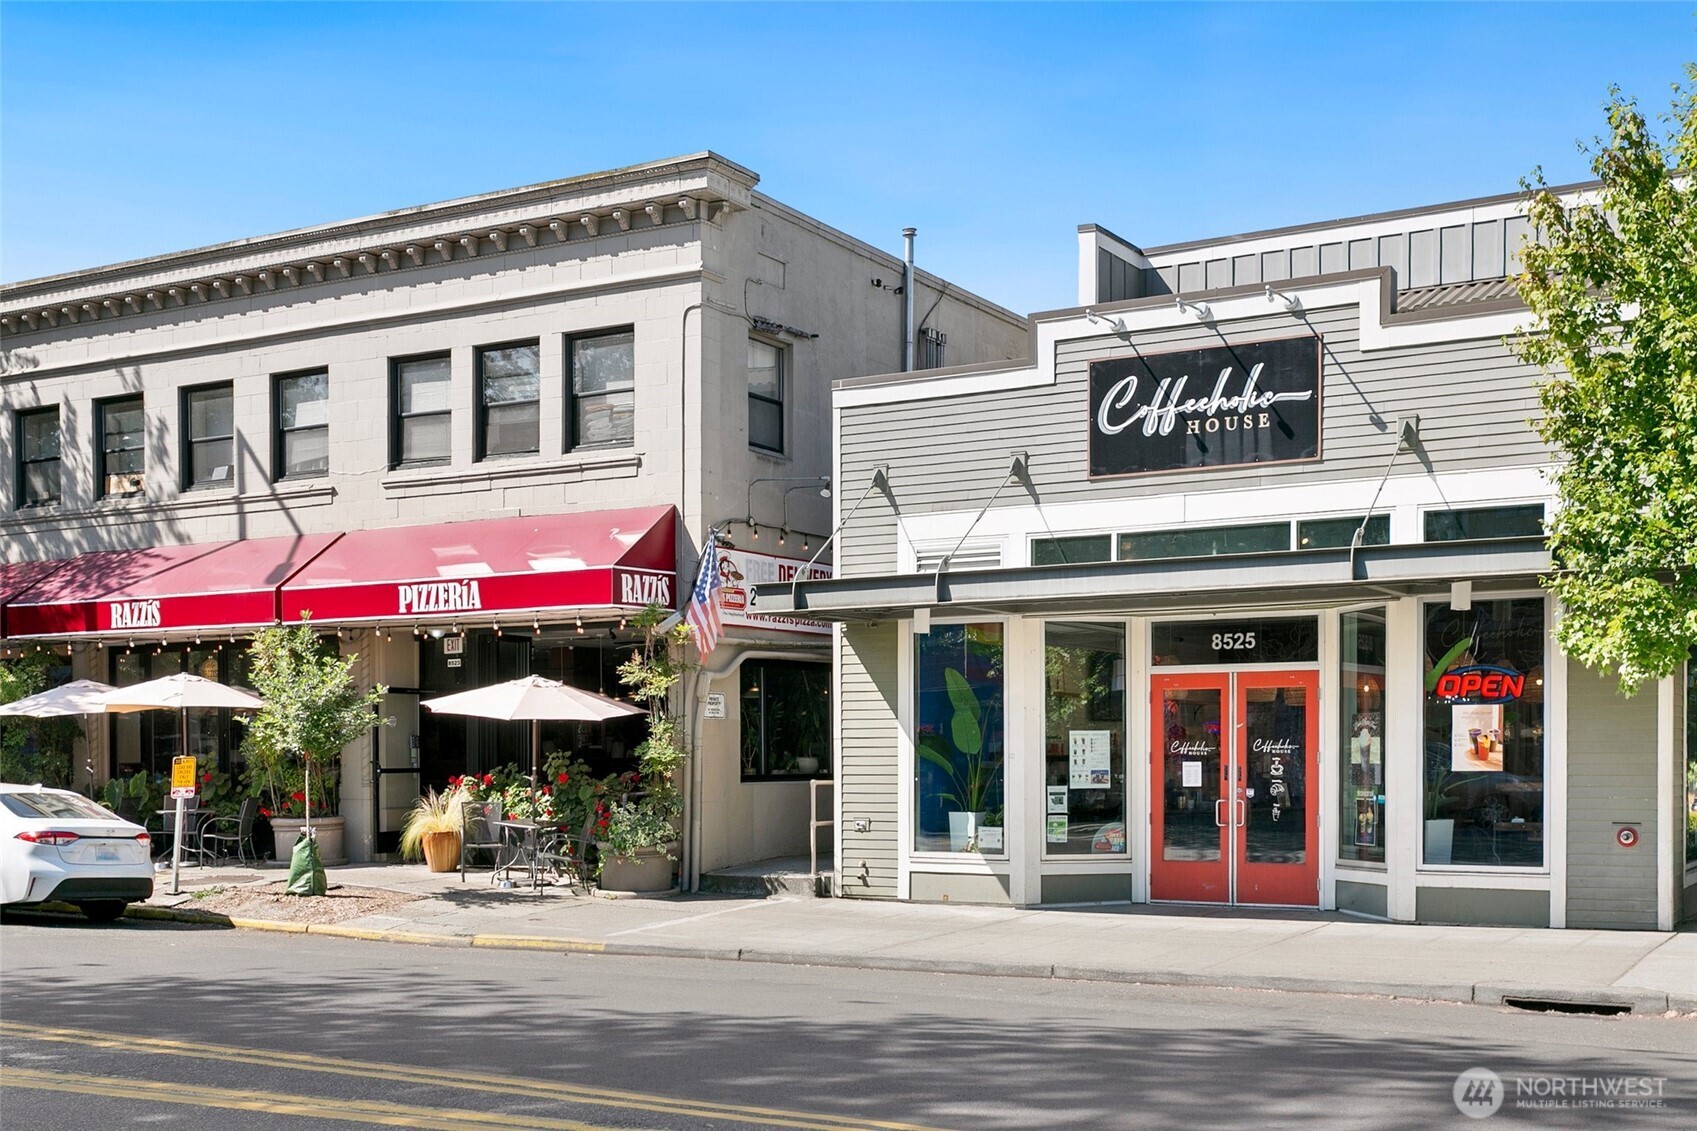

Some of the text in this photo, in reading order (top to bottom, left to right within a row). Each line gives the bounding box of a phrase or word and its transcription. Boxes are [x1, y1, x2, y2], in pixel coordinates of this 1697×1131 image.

[1098, 362, 1312, 437] Coffeeholic
[1186, 412, 1270, 435] HOUSE
[746, 559, 775, 583] FREE
[447, 638, 460, 652] EXIT
[1211, 632, 1256, 650] 8525
[1436, 674, 1525, 698] OPEN
